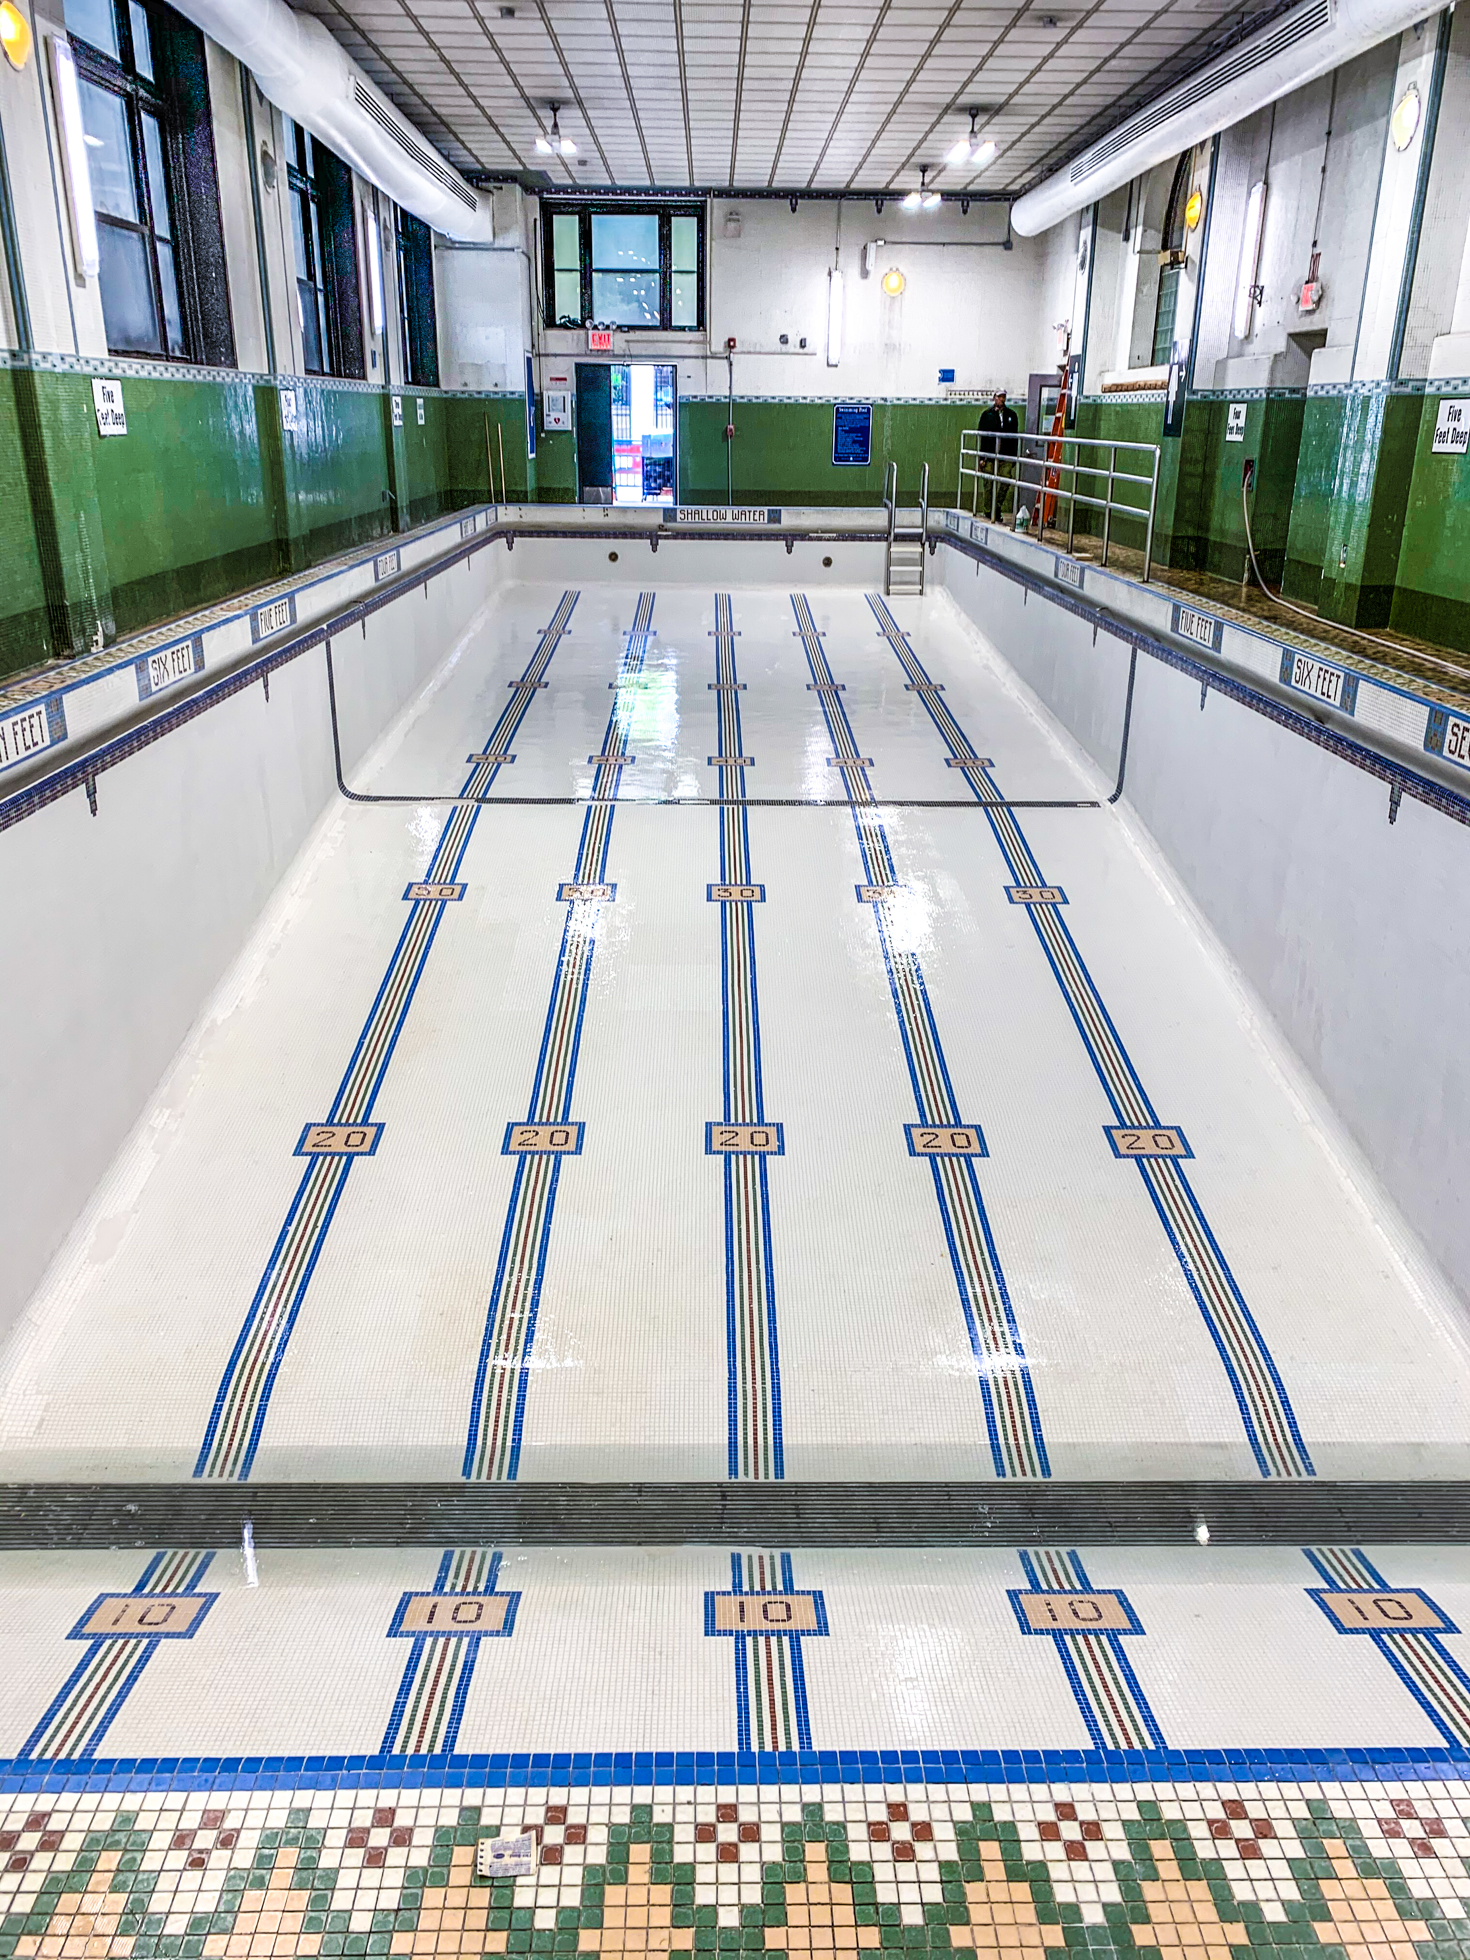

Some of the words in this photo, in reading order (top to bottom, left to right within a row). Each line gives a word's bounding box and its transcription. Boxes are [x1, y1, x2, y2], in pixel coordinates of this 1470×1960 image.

[591, 332, 612, 349] EXIT
[102, 385, 115, 403] Five
[111, 409, 125, 428] Deep
[1447, 405, 1462, 422] Five
[1435, 427, 1450, 444] Feet
[1450, 427, 1468, 447] Deep
[679, 509, 727, 521] SHALLOW
[731, 509, 765, 521] WATER
[260, 608, 274, 635] FIVE
[274, 601, 289, 627] FEET
[1180, 610, 1195, 635] FIVE
[1196, 616, 1212, 644] FEET
[151, 654, 170, 686] SIX
[171, 645, 191, 678] FEET
[1294, 658, 1314, 690] SIX
[1315, 666, 1341, 701] FEET
[12, 710, 44, 755] FEET
[1448, 722, 1470, 760] SE
[415, 886, 455, 896] 30
[717, 888, 755, 898] 30
[1016, 890, 1056, 900] 30
[311, 1130, 368, 1148] 20
[517, 1129, 569, 1146] 20
[719, 1130, 769, 1147] 20
[920, 1131, 972, 1149] 20
[1121, 1133, 1176, 1150] 20
[111, 1603, 177, 1626] 10
[426, 1601, 483, 1624] 10
[738, 1601, 793, 1623] 10
[1044, 1599, 1104, 1622] 10
[1347, 1598, 1413, 1621] 10
